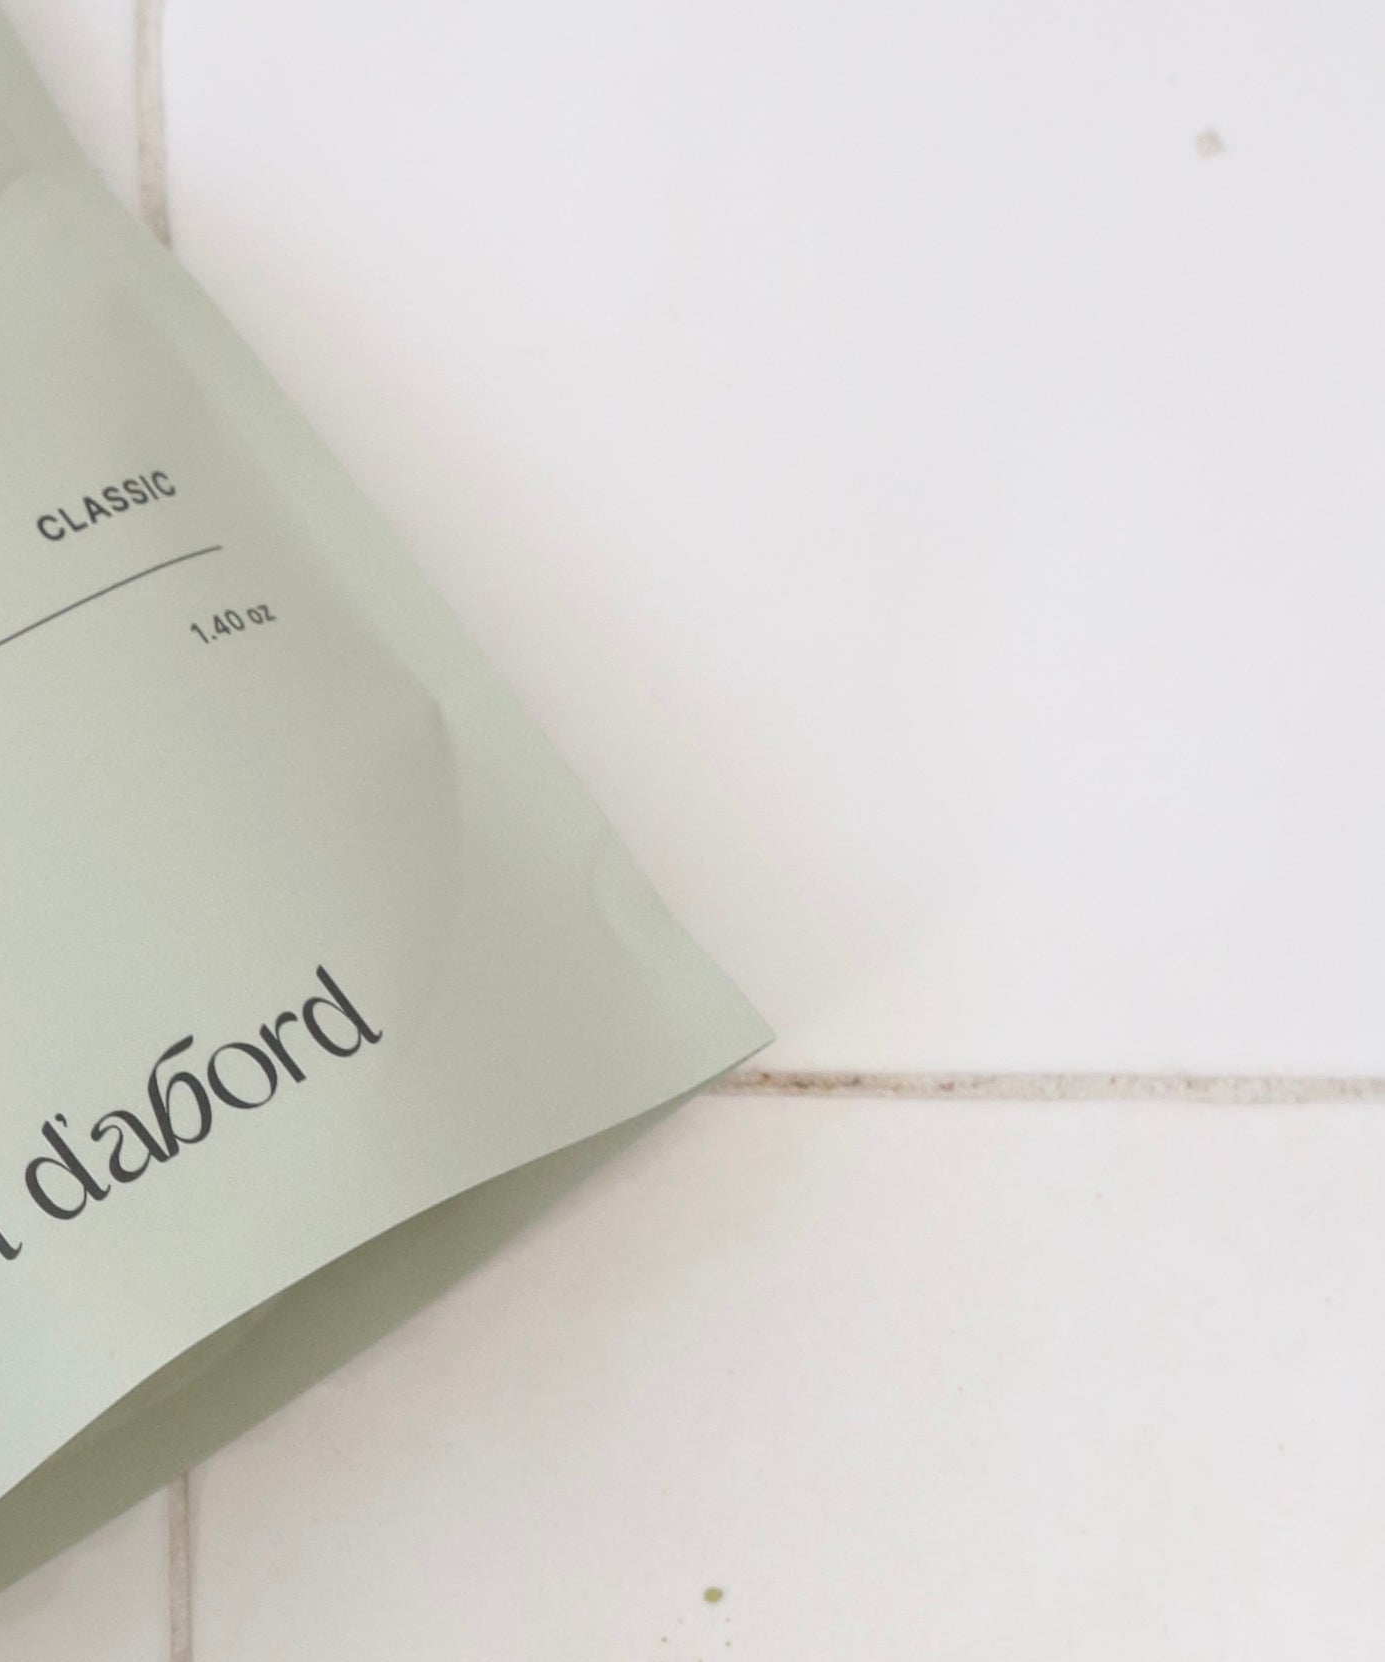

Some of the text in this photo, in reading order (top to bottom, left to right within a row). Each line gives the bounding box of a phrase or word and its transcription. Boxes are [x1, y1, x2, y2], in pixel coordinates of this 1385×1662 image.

[36, 470, 176, 541] CLASSIC
[190, 604, 276, 644] 1.40 oz
[25, 964, 382, 1220] d'abord
